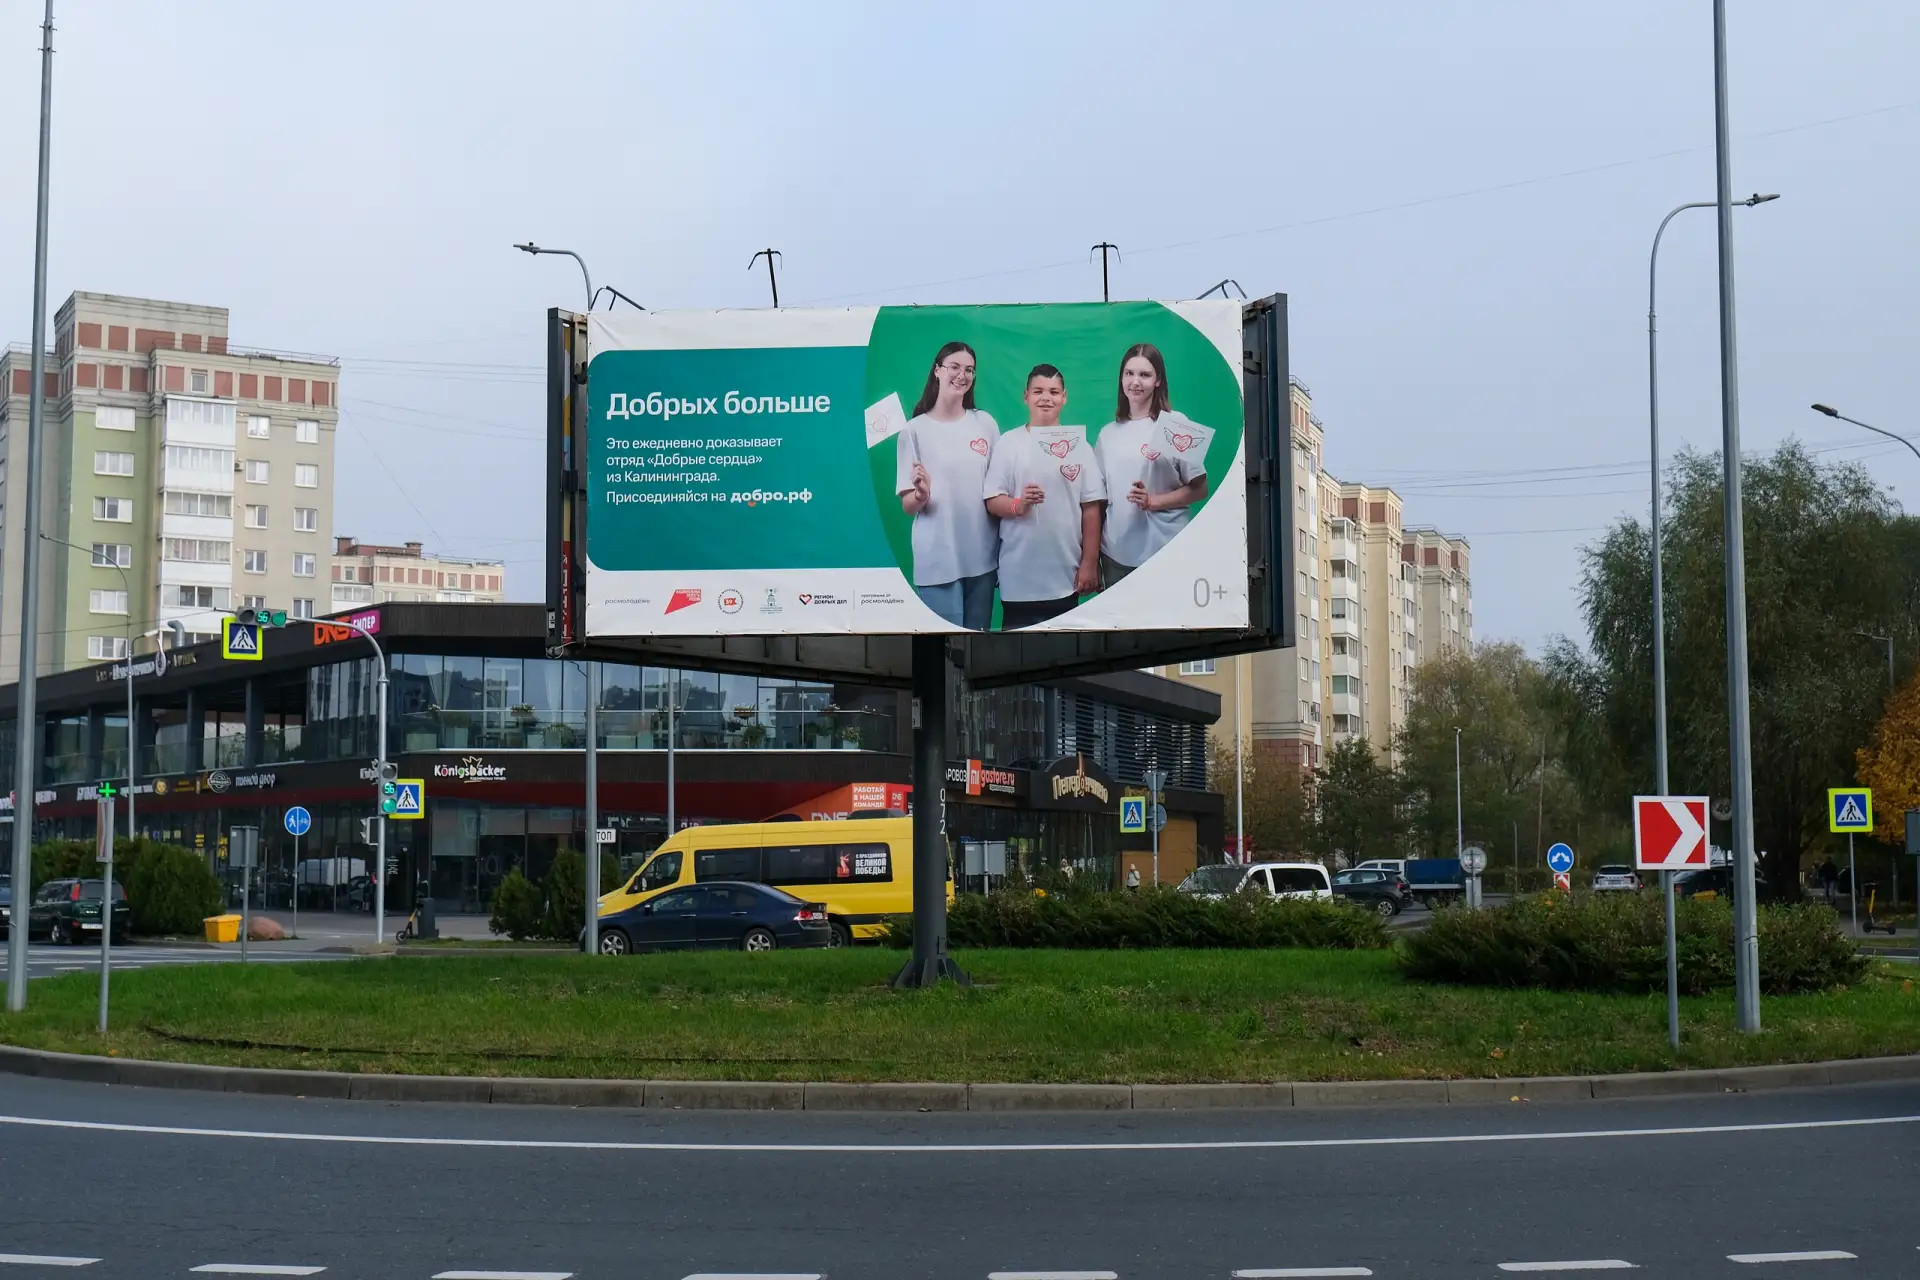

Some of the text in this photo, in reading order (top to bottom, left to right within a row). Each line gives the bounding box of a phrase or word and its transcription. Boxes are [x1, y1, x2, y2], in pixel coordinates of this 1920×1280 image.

[606, 390, 831, 421] Добрых больше
[606, 436, 783, 451] Это ежедневно доказывает
[606, 453, 763, 468] отряд «Добрые сердца»
[606, 471, 720, 484] из Калининграда.
[606, 488, 813, 505] Присоединяйся на добро.рф
[1193, 577, 1229, 608] 0+
[257, 611, 268, 623] 56
[314, 616, 351, 646] DNS
[384, 784, 395, 794] 56
[853, 785, 885, 793] РАБОТАЙ
[855, 858, 887, 867] ВЕЛИКОЙ
[855, 866, 887, 875] ПОБЕДЫ!
